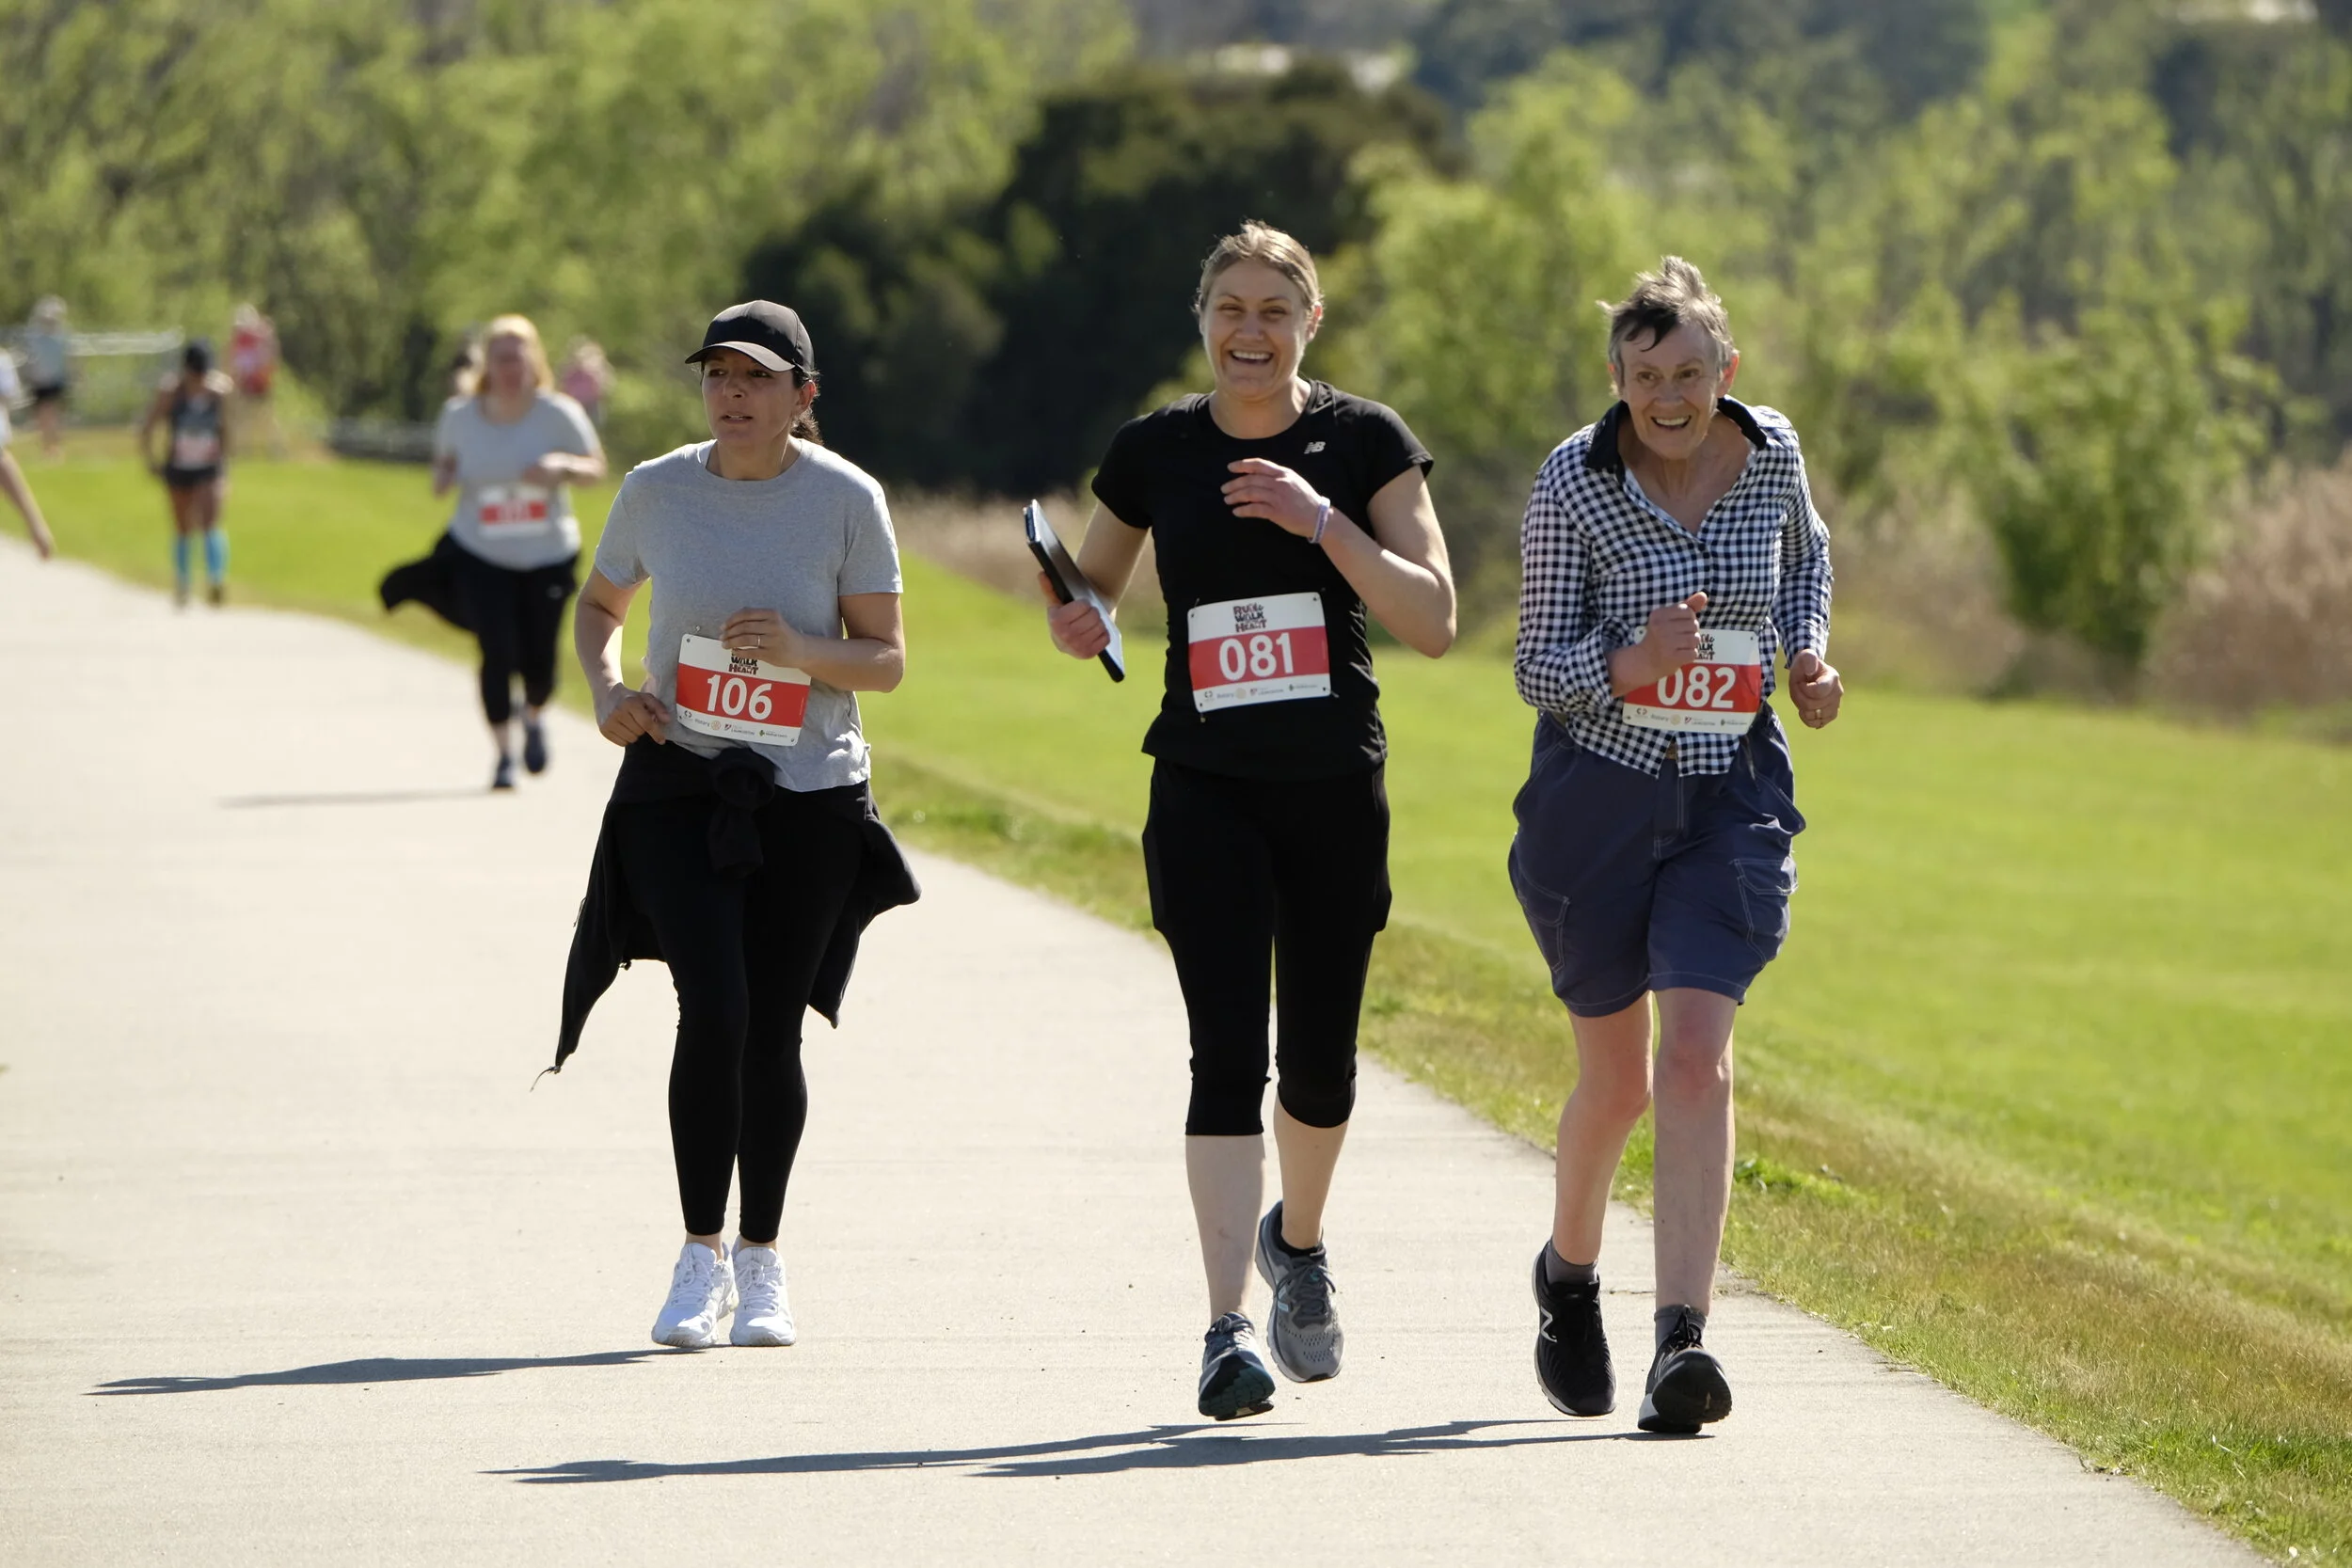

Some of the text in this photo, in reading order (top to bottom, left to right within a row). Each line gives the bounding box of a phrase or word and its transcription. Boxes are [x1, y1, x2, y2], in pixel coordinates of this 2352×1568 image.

[1234, 611, 1264, 622] WALK
[1235, 619, 1266, 632] HEART
[731, 657, 757, 667] WALK
[1219, 632, 1294, 681] 081
[728, 663, 758, 675] HEART
[1658, 666, 1736, 708] 082
[707, 674, 772, 720] 106
